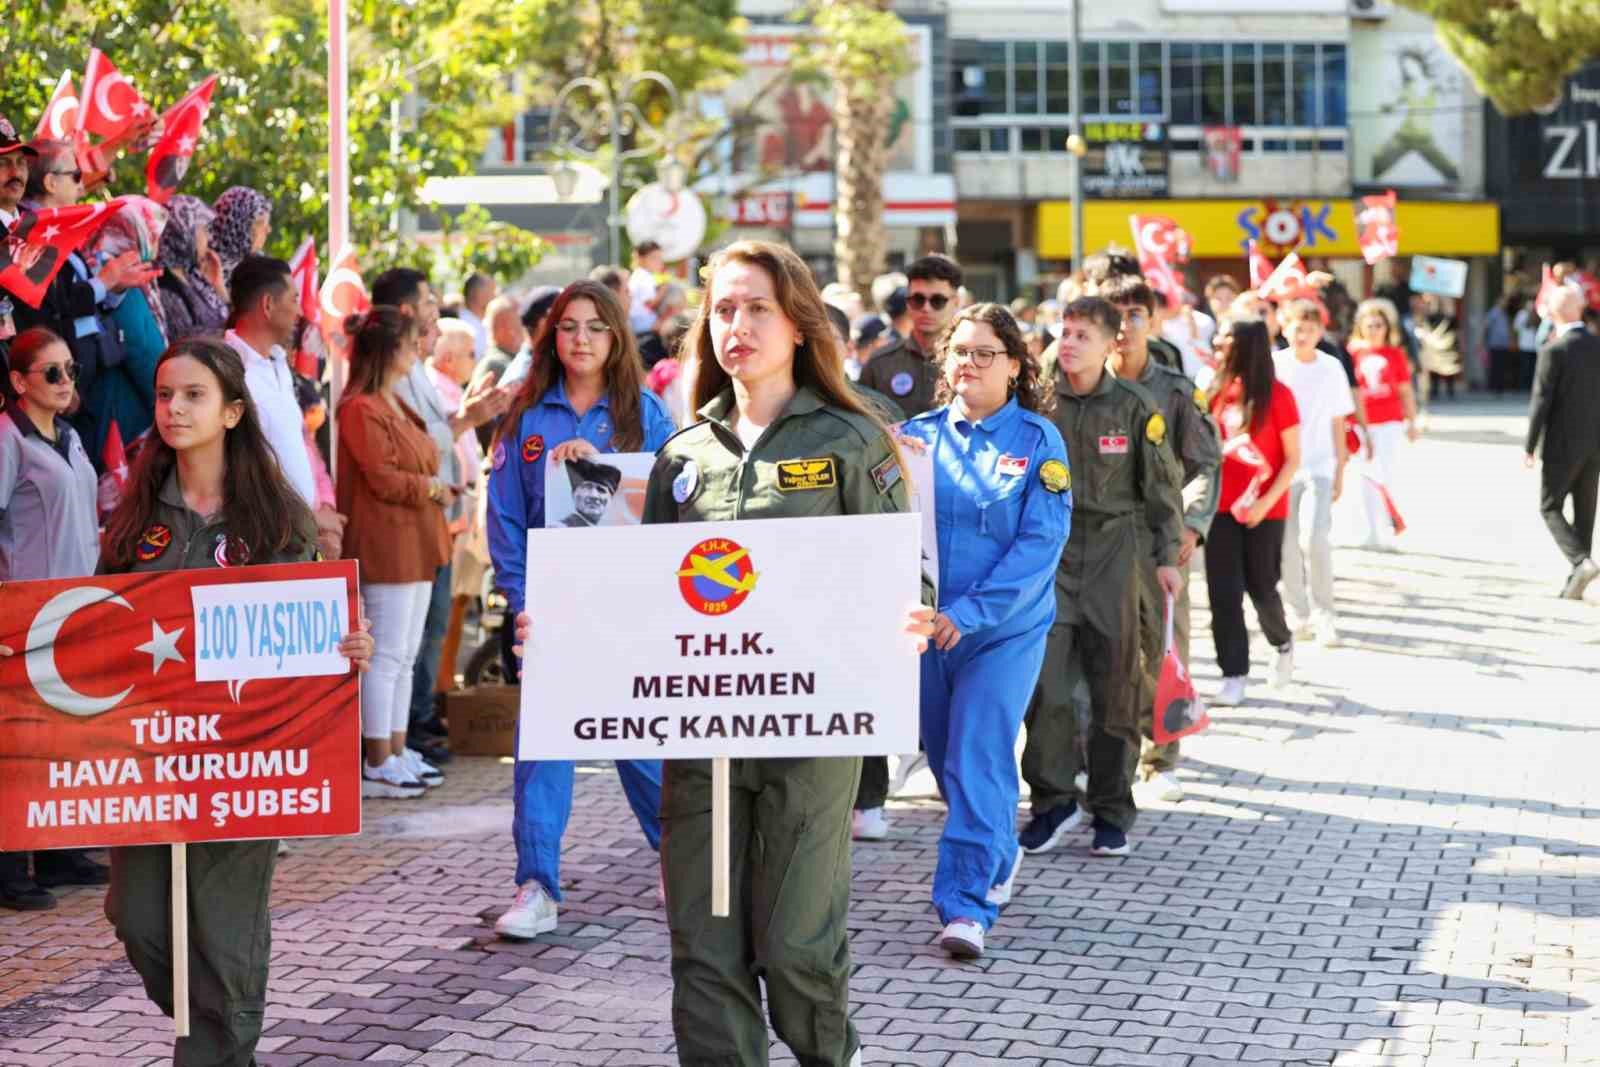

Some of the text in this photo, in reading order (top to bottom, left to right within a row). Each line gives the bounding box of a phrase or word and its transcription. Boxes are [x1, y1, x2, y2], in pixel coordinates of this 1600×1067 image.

[200, 599, 341, 670] 100 YAŞINDA
[675, 632, 774, 657] T.H.K.
[632, 672, 816, 698] MENEMEN
[131, 710, 222, 744] TÜRK
[573, 712, 875, 746] GENÇ KANATLAR
[49, 749, 309, 788] HAVA KURUMU
[27, 779, 332, 828] MENEMEN ŞUBESİ
